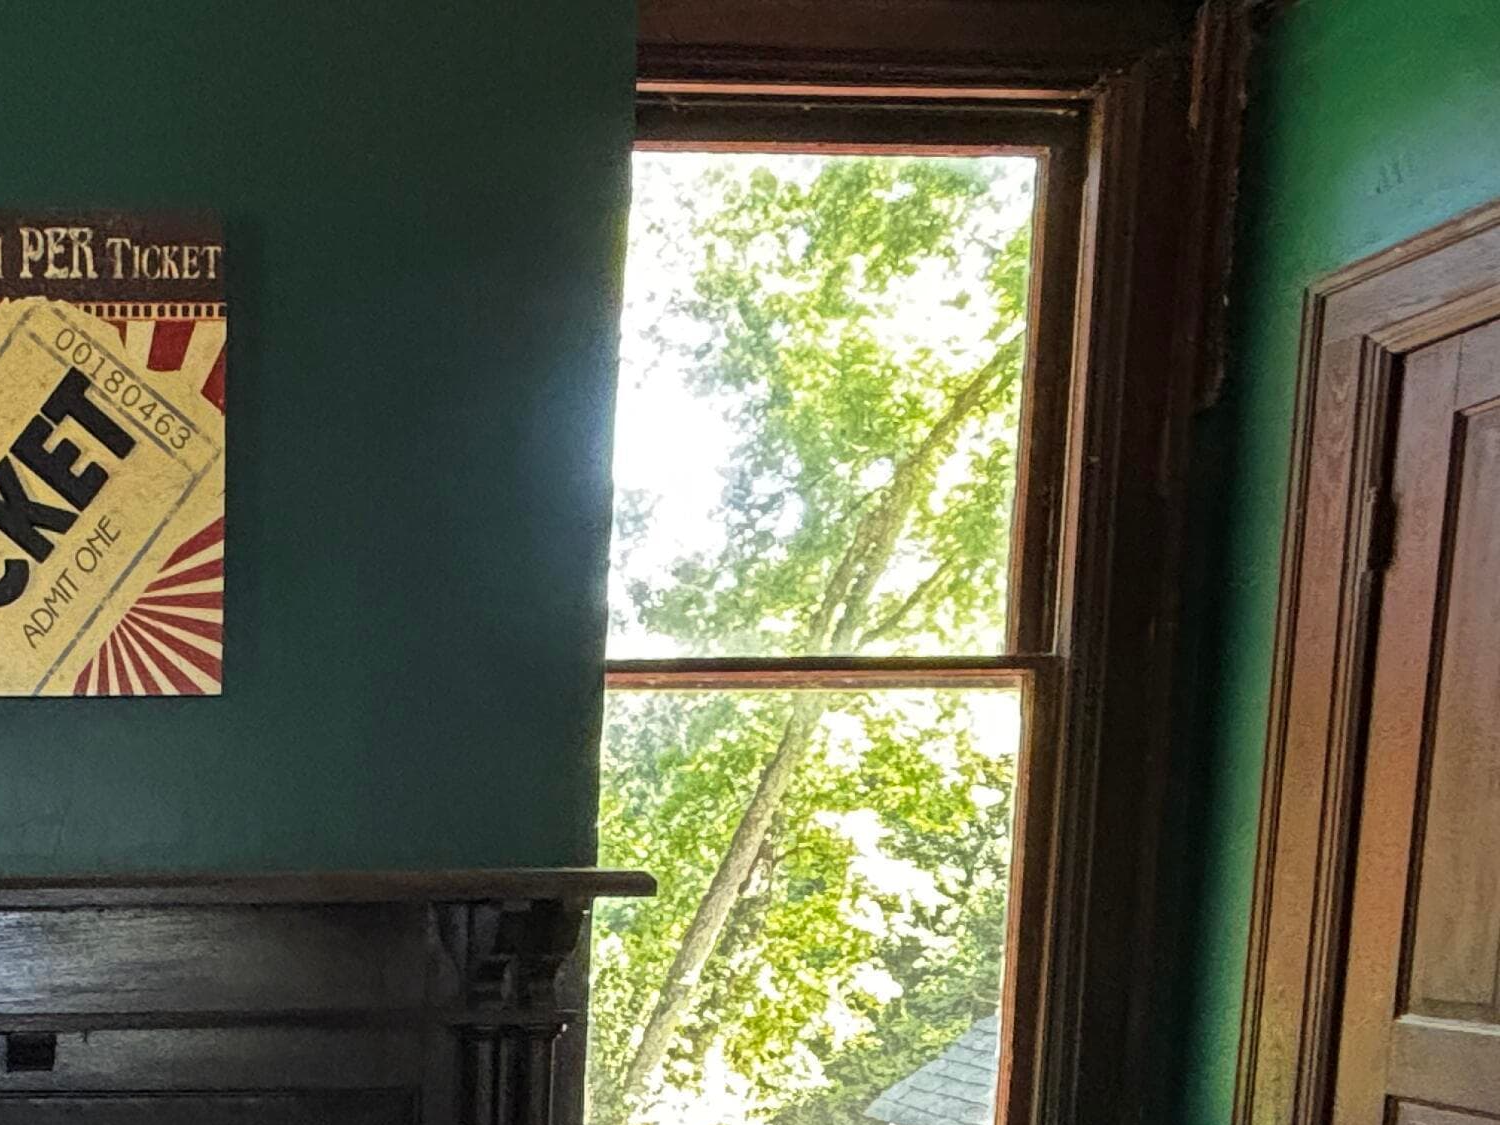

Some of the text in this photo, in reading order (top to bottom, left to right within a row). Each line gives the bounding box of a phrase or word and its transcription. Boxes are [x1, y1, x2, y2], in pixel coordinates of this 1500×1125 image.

[19, 226, 98, 280] PER
[54, 328, 192, 450] 00180463
[22, 514, 121, 649] ADMIT ONE
